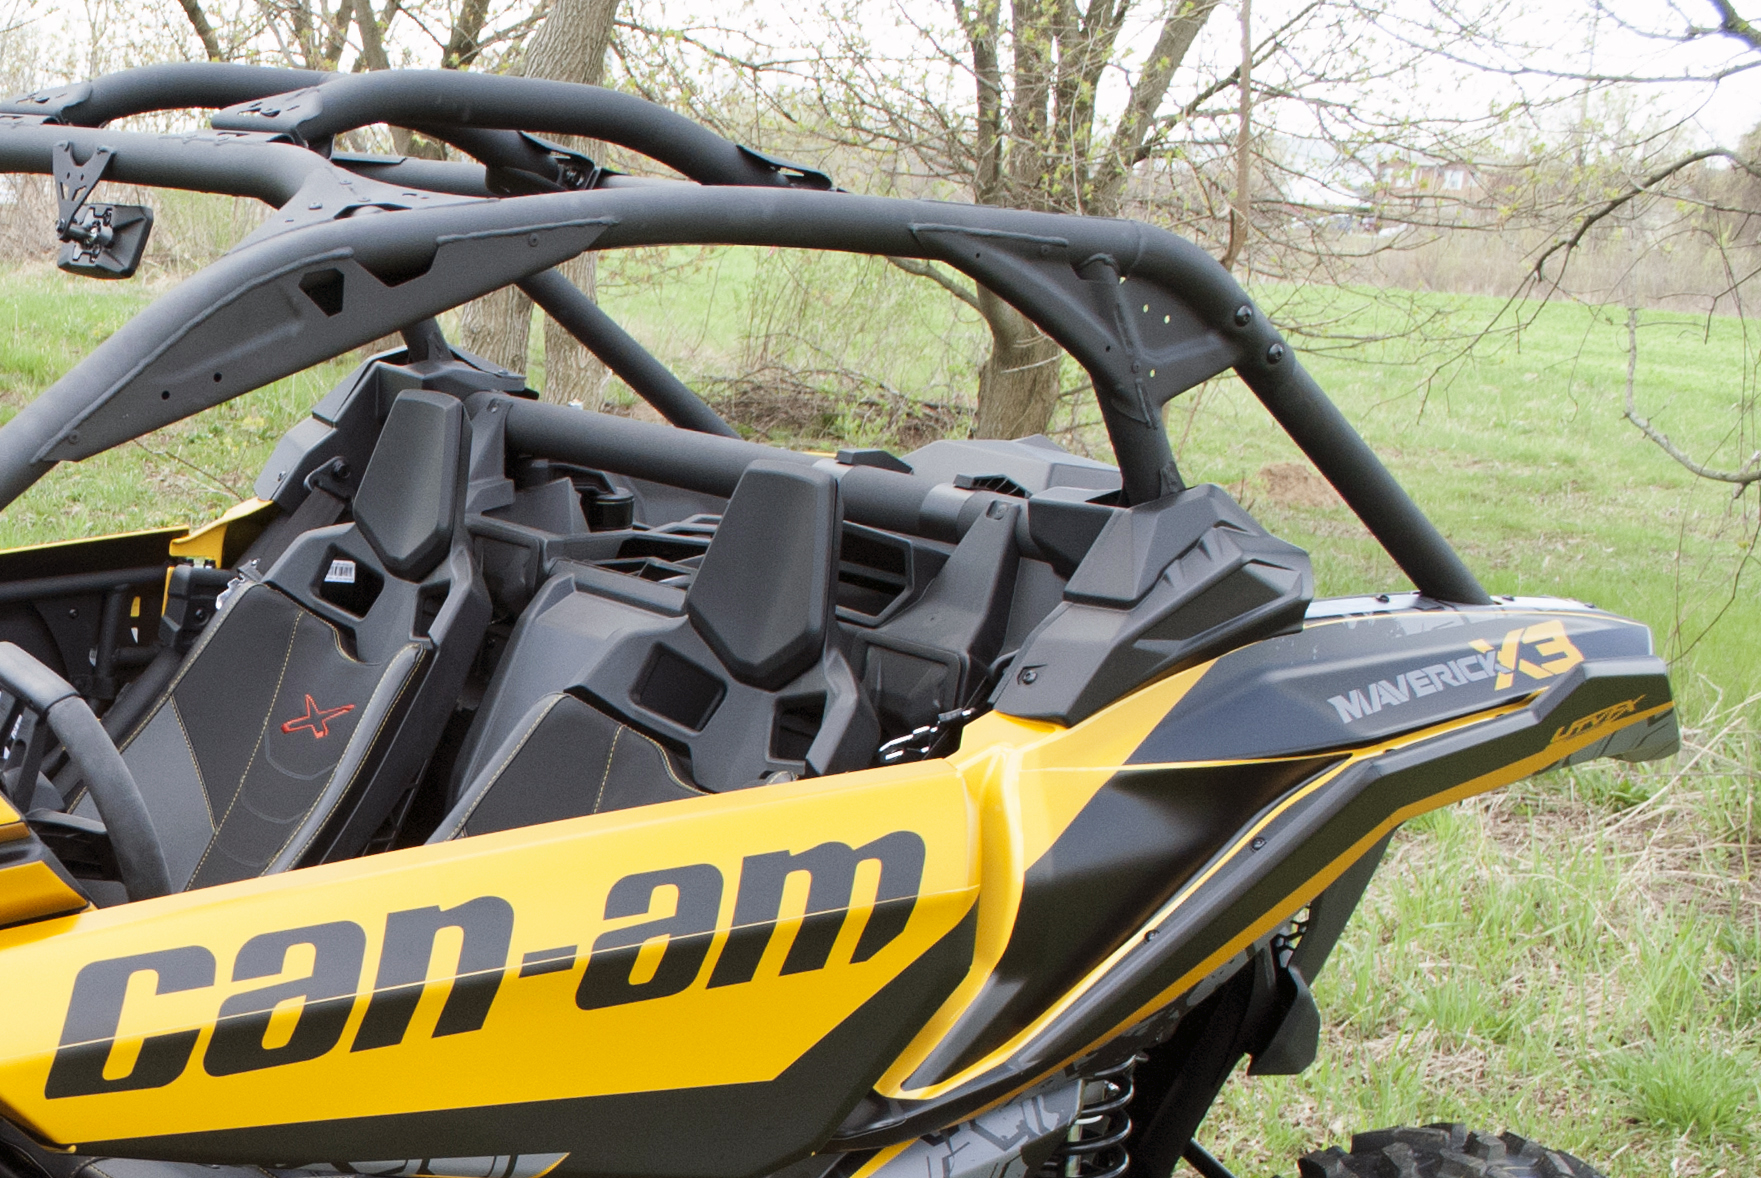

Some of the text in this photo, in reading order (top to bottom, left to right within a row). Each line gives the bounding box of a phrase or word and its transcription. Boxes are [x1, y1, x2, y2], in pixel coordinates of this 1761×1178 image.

[1327, 619, 1585, 724] MAVERICK X3
[44, 829, 926, 1100] can-am
